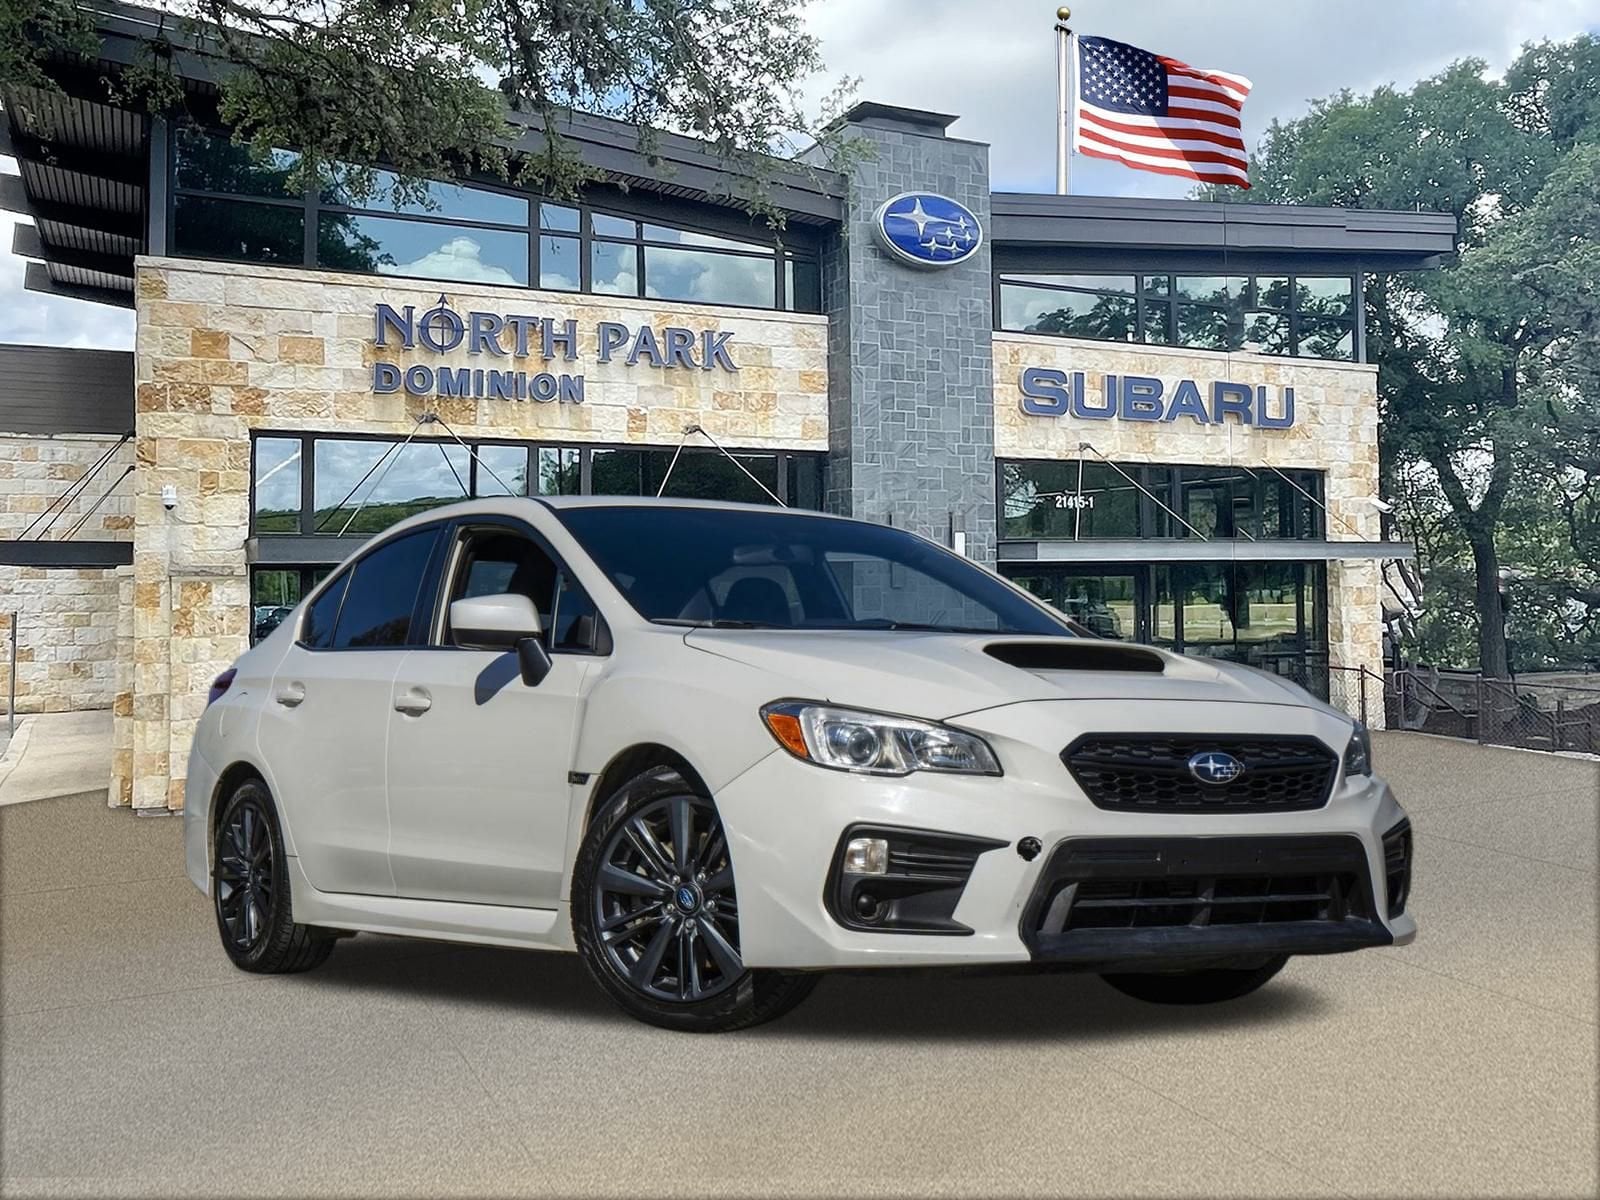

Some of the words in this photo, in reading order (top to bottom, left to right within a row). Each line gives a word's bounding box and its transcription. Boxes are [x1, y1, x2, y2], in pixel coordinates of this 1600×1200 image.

[374, 298, 580, 362] NORTH
[597, 321, 743, 373] PARK
[373, 362, 586, 405] DOMINION
[1018, 367, 1295, 430] SUBARU
